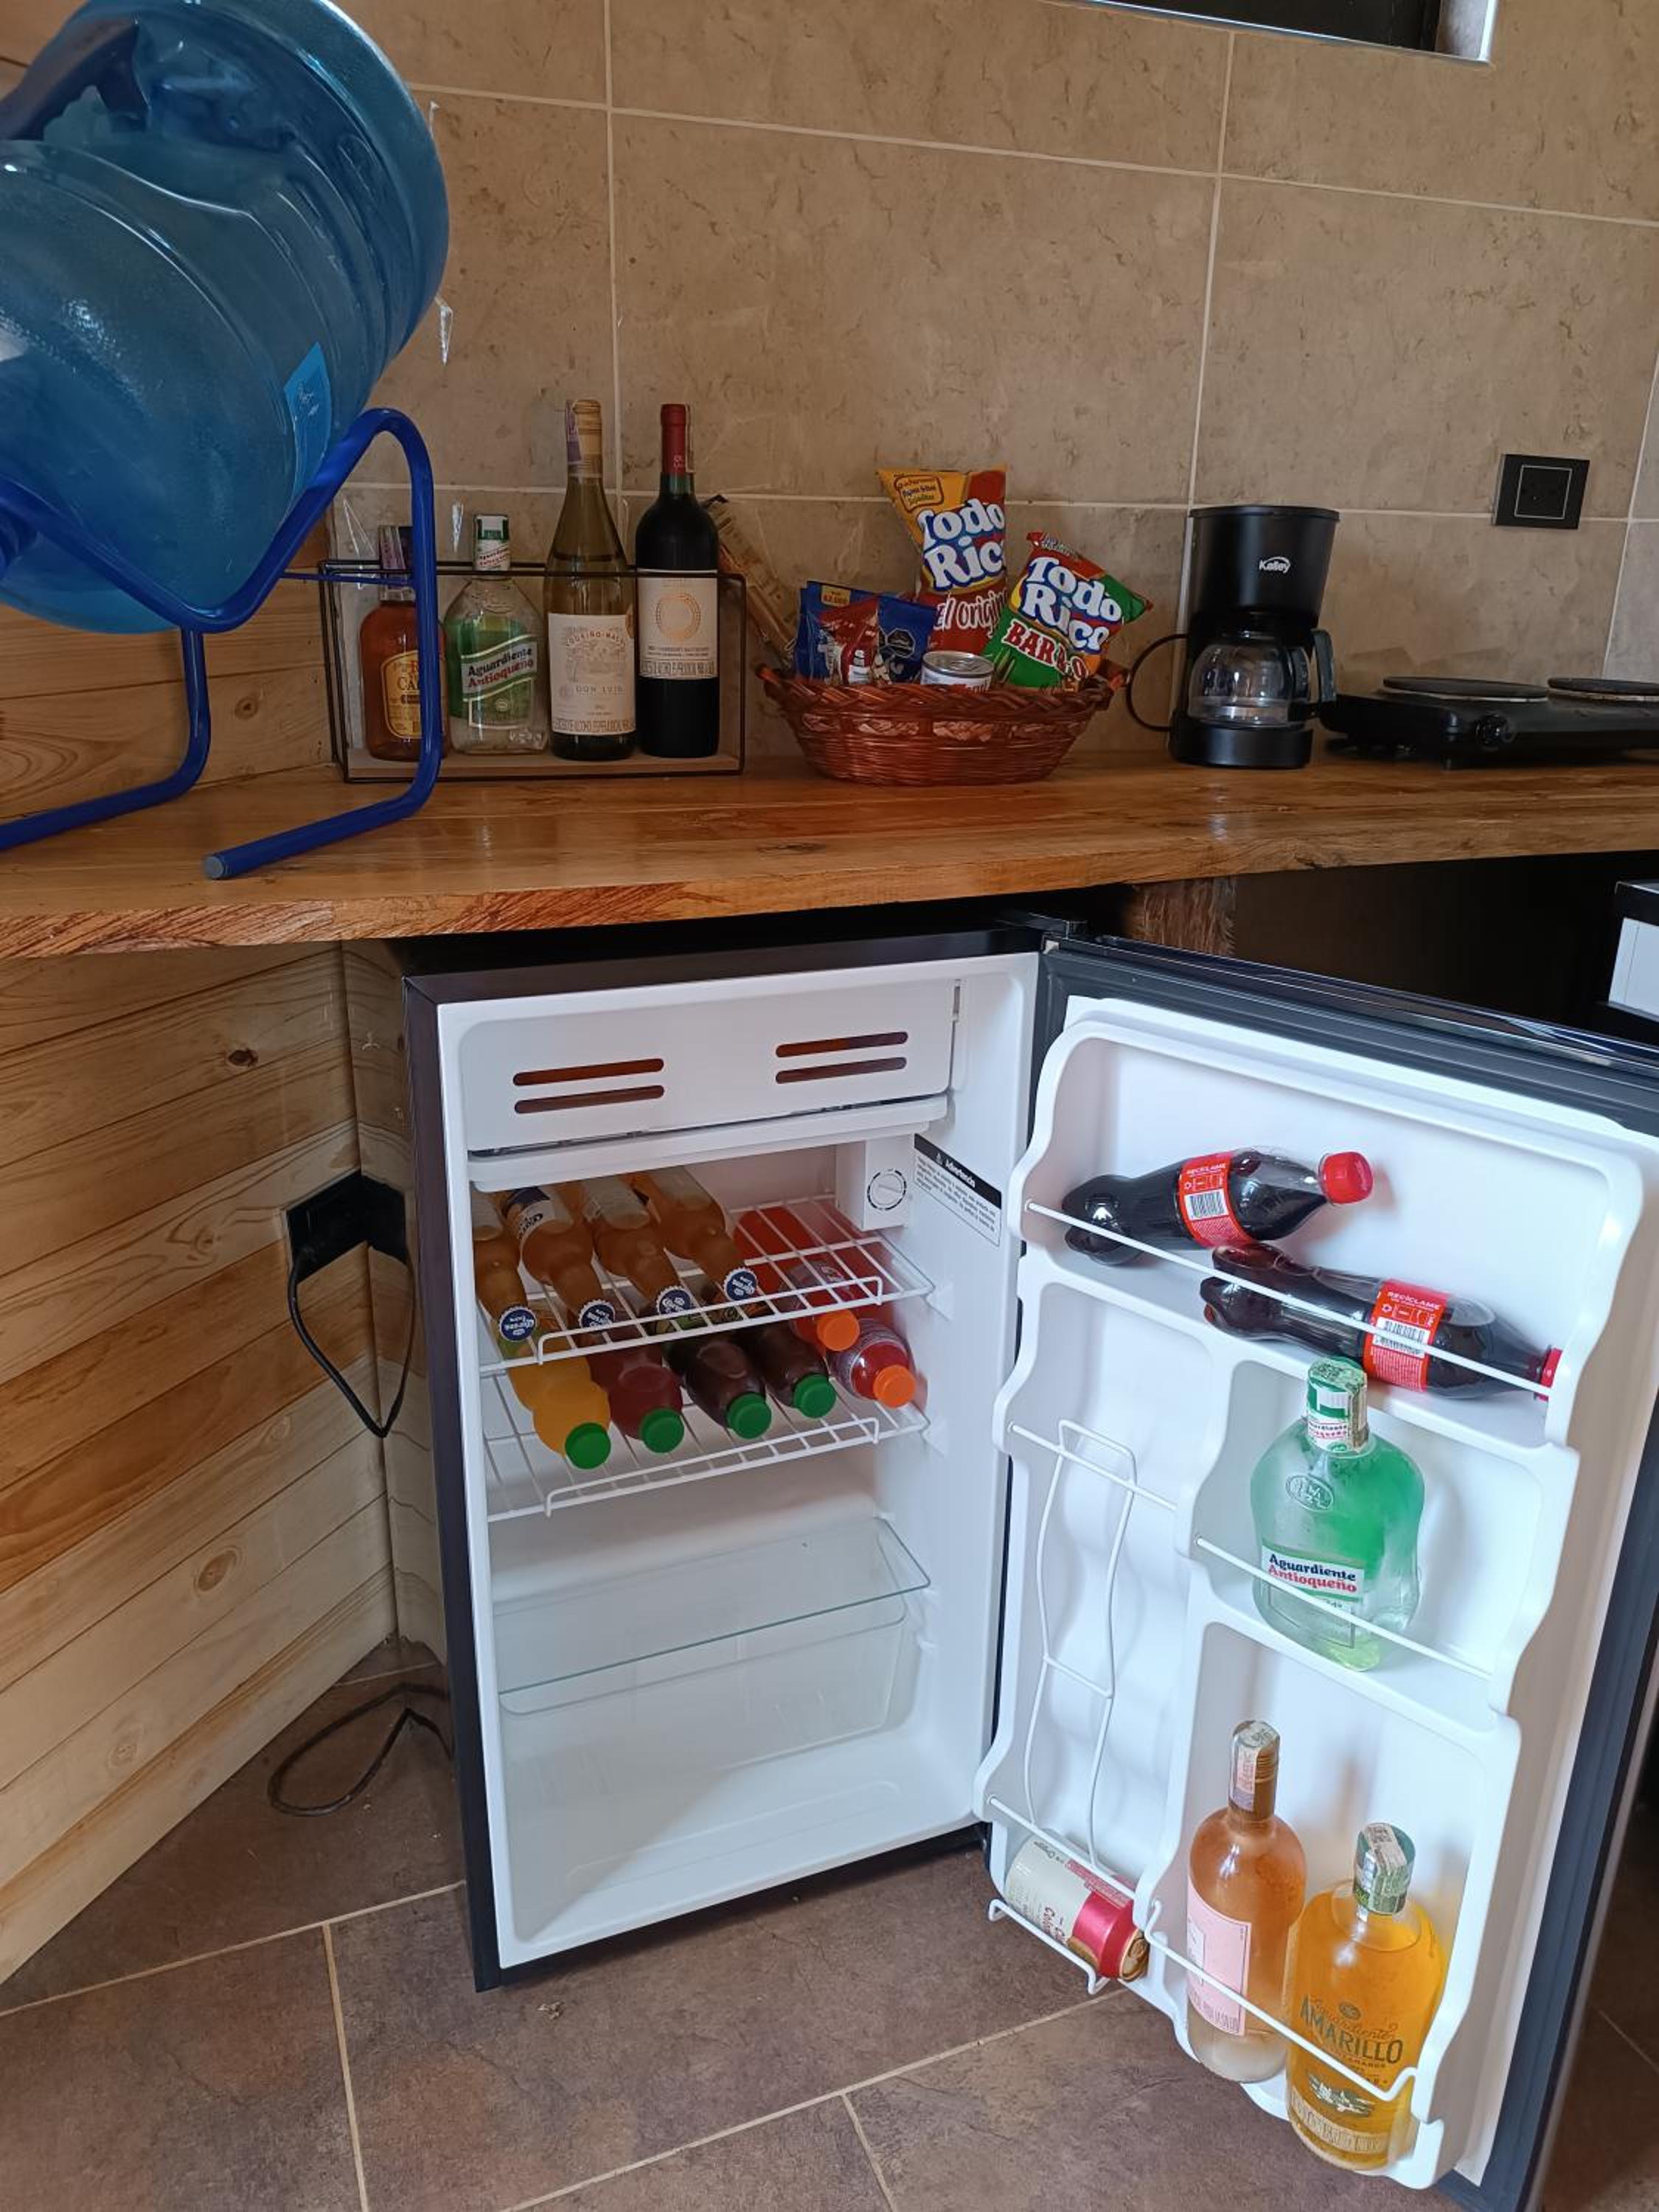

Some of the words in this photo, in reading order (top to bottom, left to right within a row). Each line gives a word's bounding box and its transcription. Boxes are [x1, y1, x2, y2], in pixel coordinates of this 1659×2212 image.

[925, 536, 1006, 588] Ric
[1259, 557, 1290, 574] Kalley
[1026, 557, 1121, 622] Todo
[468, 648, 532, 676] Aguardiente
[1268, 1563, 1357, 1593] Antioqueño
[1269, 1553, 1357, 1582] Aguardiente
[1300, 1993, 1403, 2065] AMARILLO
